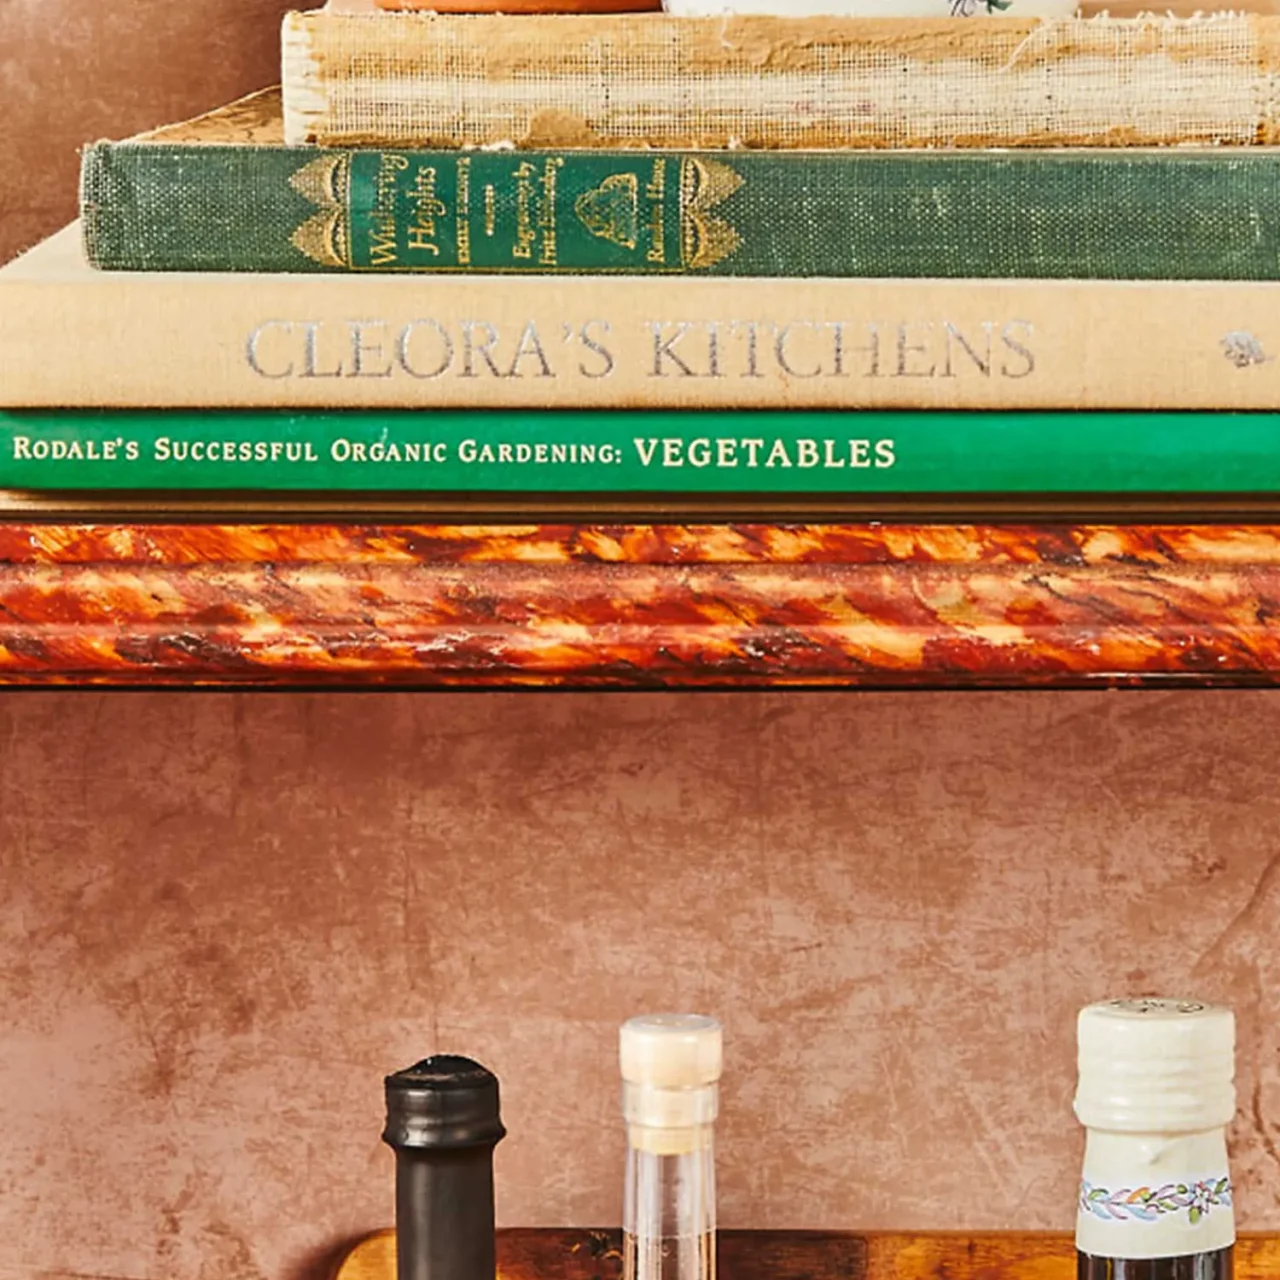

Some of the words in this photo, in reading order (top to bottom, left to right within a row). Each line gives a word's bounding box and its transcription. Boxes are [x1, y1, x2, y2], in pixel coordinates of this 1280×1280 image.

[512, 162, 538, 178] by
[645, 158, 665, 199] House
[405, 166, 446, 256] Heights
[645, 204, 665, 263] Random
[245, 318, 615, 379] CLEORA'S
[643, 319, 1036, 379] KITCHENS
[12, 436, 140, 460] RODALE'S
[154, 436, 319, 462] SUCCESSFUL
[331, 438, 447, 463] ORGANIC
[458, 438, 623, 464] GARDENING:
[633, 438, 896, 469] VEGETABLES
